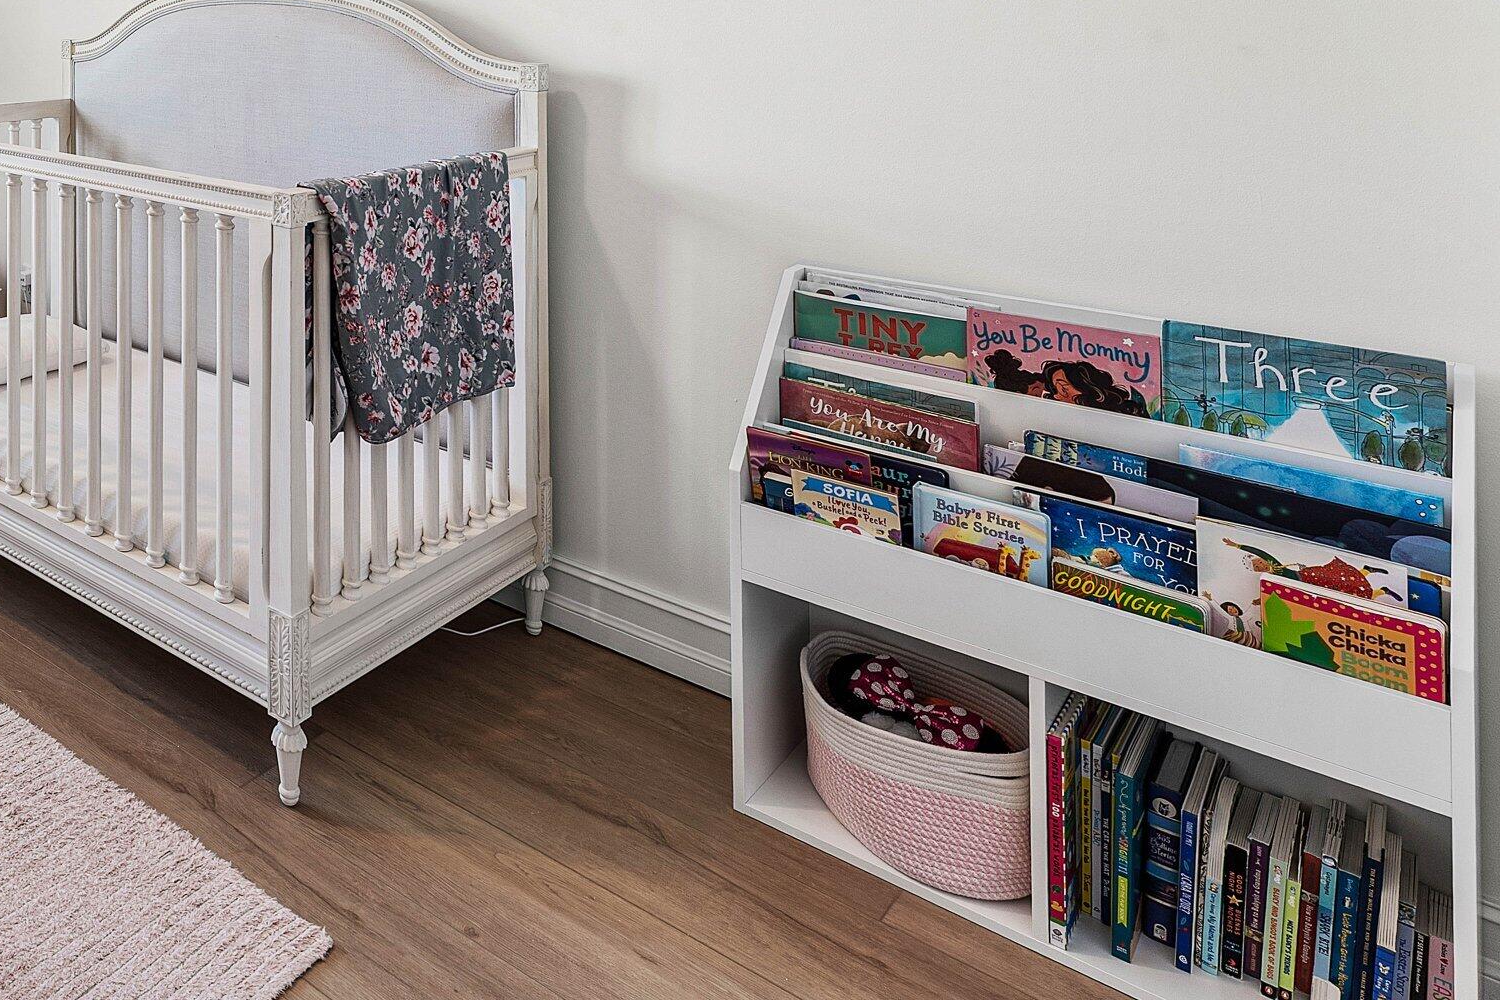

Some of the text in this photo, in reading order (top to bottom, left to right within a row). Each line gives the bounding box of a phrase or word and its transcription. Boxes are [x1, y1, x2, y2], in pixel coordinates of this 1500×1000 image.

[834, 308, 926, 345] TINY
[973, 321, 1150, 383] You Be Mommy
[1194, 336, 1409, 409] Three
[810, 396, 947, 453] You Are My
[768, 451, 801, 471] LION
[806, 462, 844, 480] KING
[823, 483, 873, 505] SOFIA
[817, 501, 845, 515] Bushel
[863, 513, 887, 527] Peck!
[932, 510, 969, 530] Bible
[973, 521, 1025, 545] Stories
[936, 497, 982, 519] Baby's
[986, 511, 1021, 530] First
[1077, 519, 1087, 538] I
[1133, 552, 1165, 571] FOR
[1055, 571, 1176, 619] GOODNIGHT
[1327, 621, 1406, 653] Chicka
[1328, 635, 1407, 667] Chicka
[1341, 651, 1408, 680] Boom
[1052, 802, 1061, 817] 100
[1268, 940, 1277, 956] BOOK
[1398, 947, 1411, 974] Easter
[1267, 965, 1275, 980] BUGS
[1393, 973, 1410, 997] Story
[1433, 976, 1453, 1000] EAS
